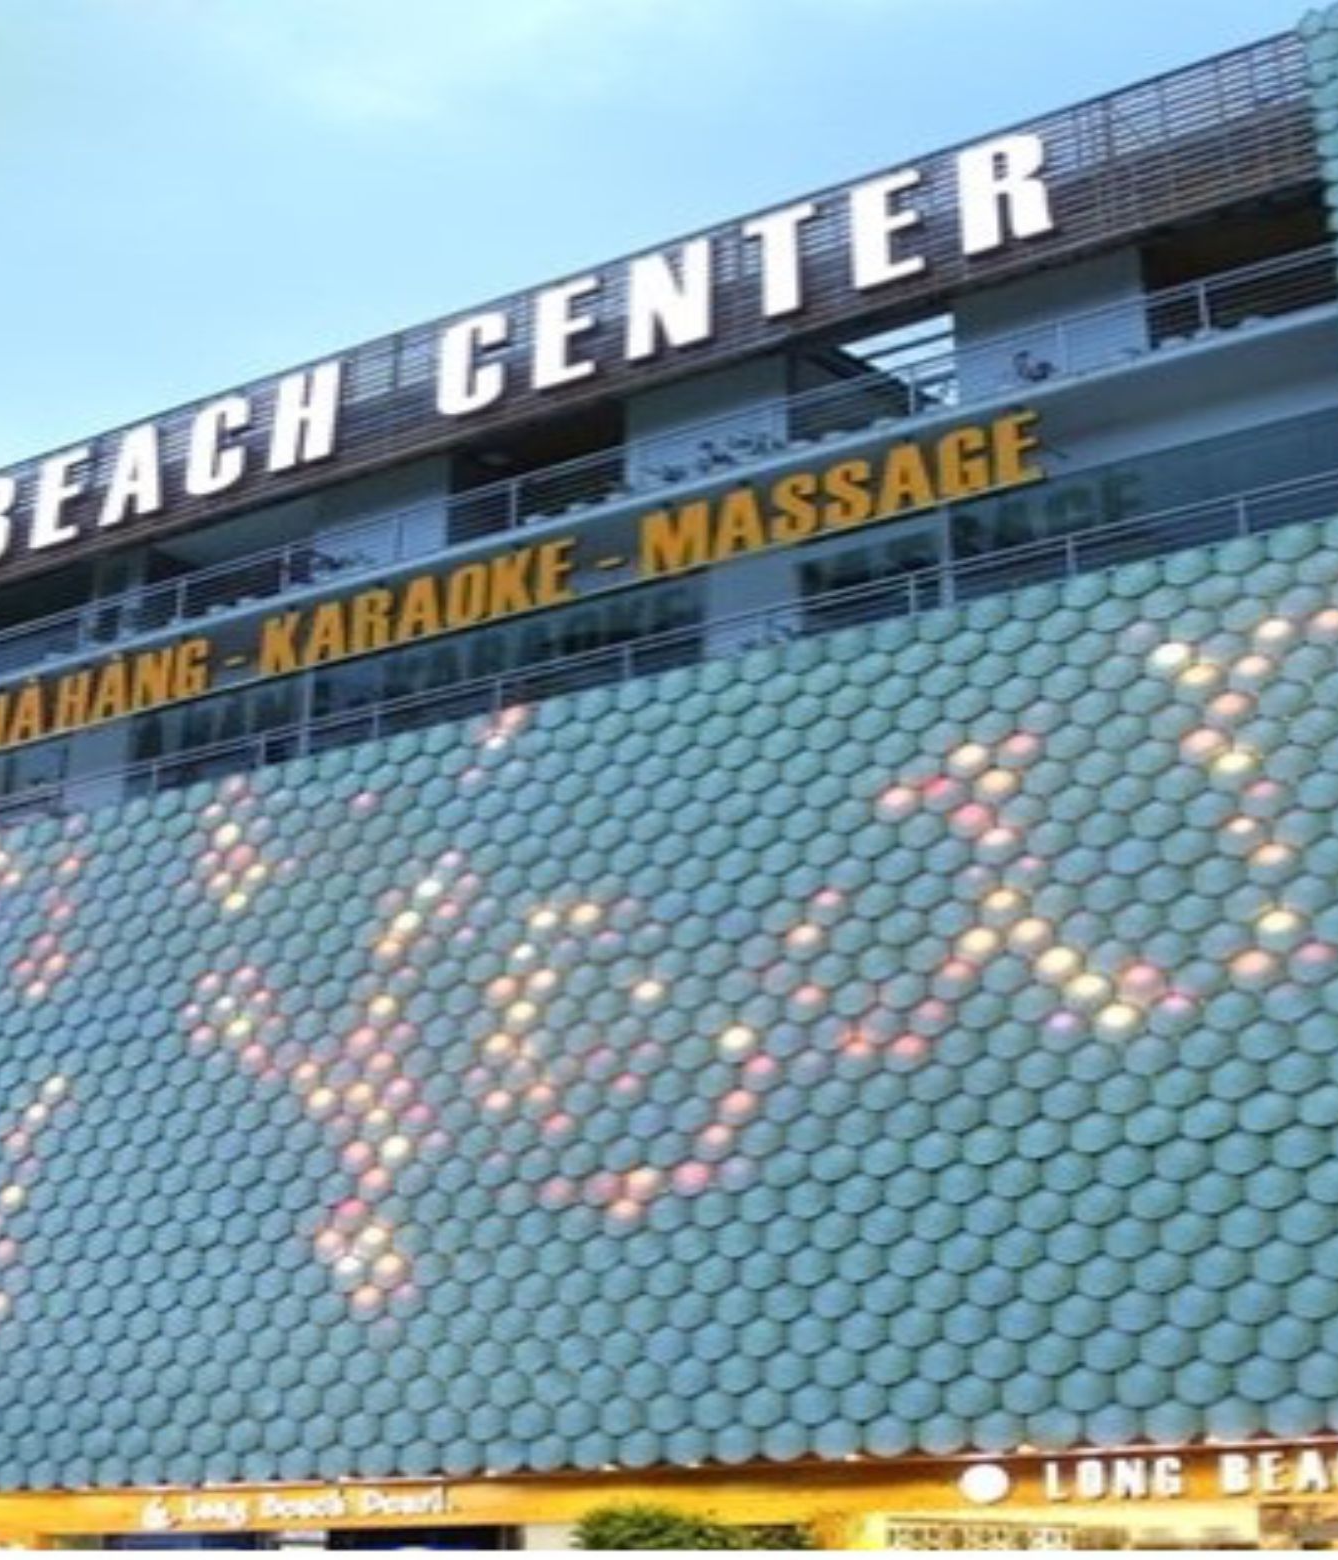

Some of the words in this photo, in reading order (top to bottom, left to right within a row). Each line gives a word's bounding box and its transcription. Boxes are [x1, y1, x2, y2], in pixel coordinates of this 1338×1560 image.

[434, 132, 1056, 417] CENTER
[259, 535, 579, 677] KARAOKE
[637, 408, 1042, 580] MASSAGE
[1042, 1457, 1184, 1500] LONG
